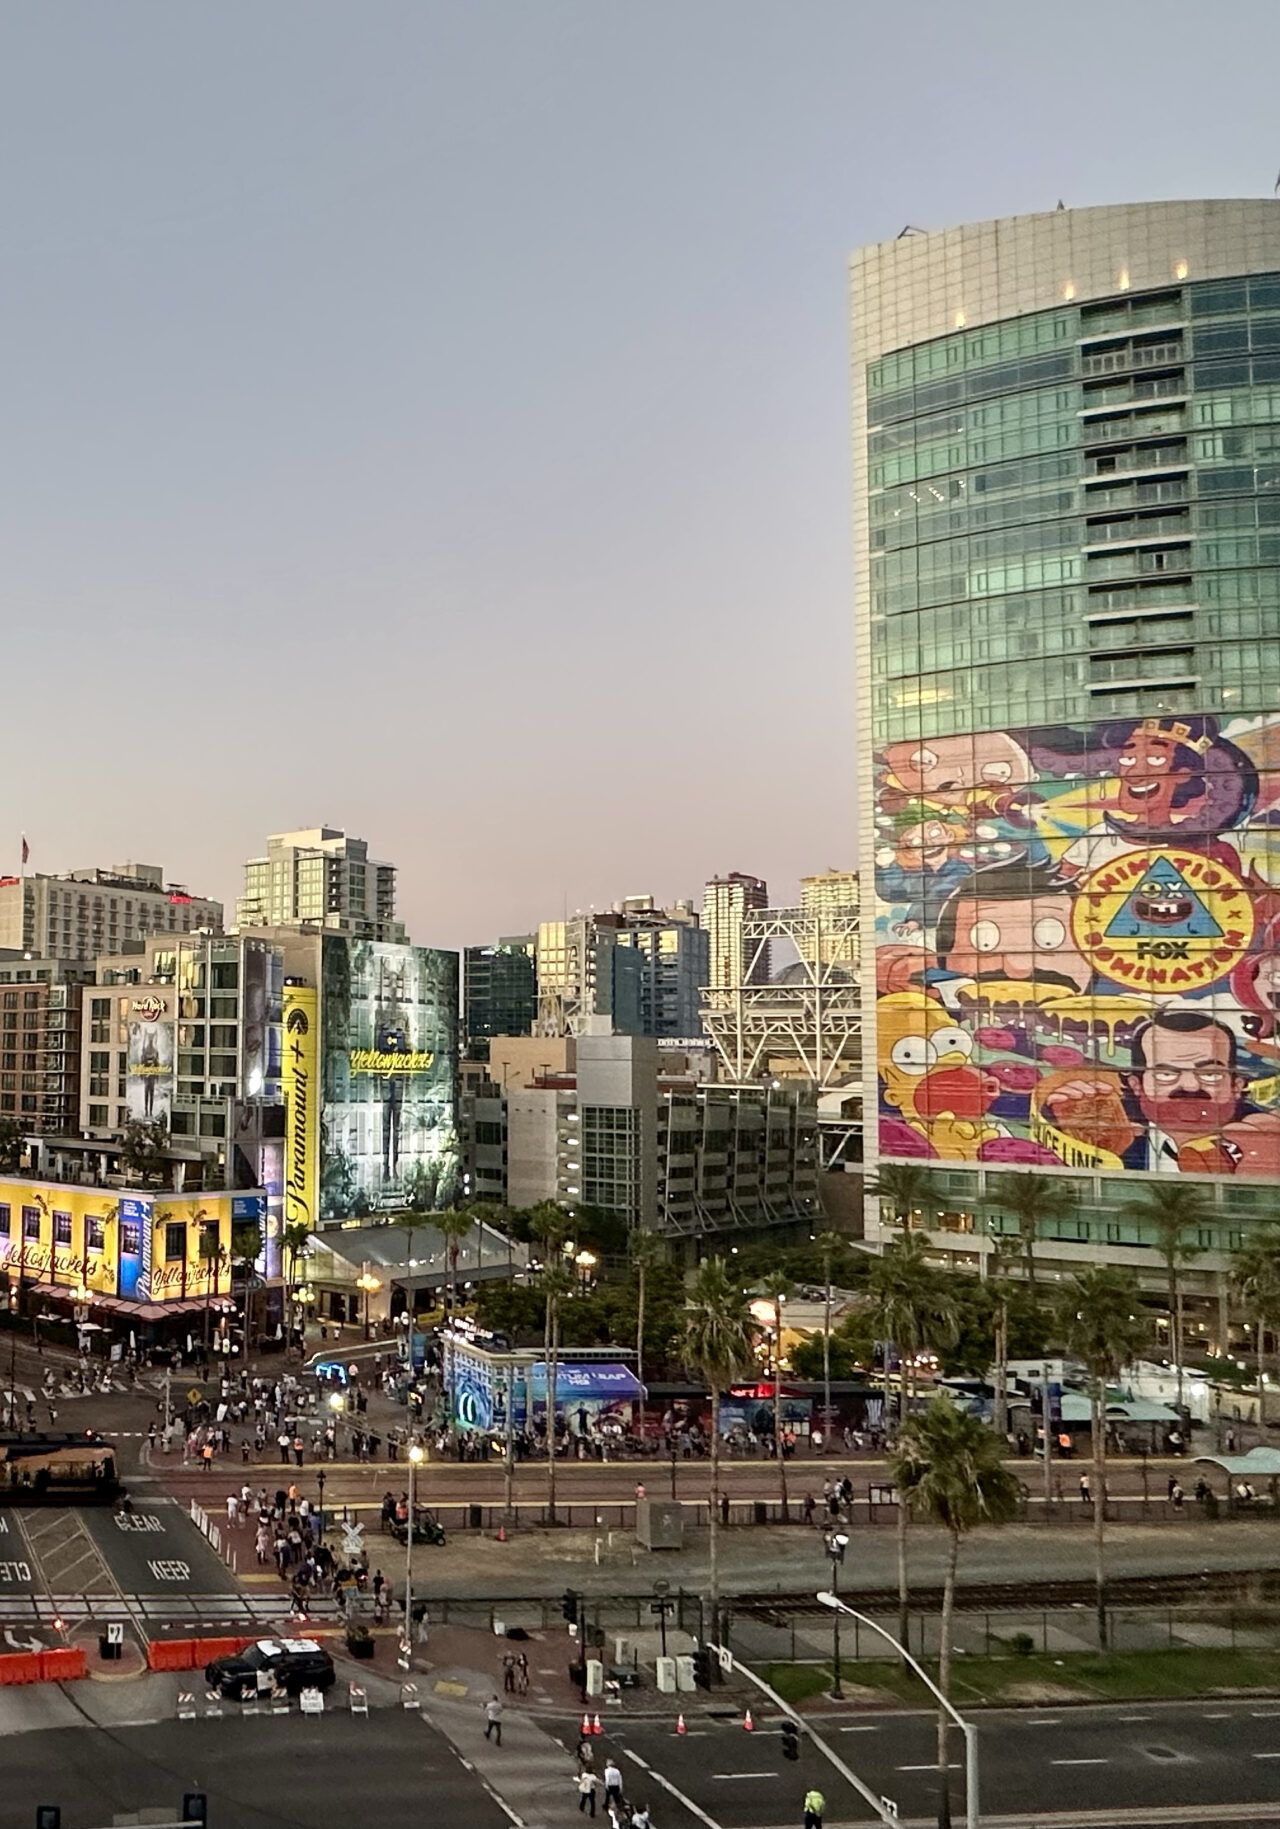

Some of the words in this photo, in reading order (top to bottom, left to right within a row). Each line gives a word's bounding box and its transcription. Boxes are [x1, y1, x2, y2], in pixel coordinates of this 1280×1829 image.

[1084, 929, 1246, 984] DOMINATION
[1137, 941, 1189, 960] FOX
[349, 1050, 435, 1078] Yellowjackets
[114, 1514, 167, 1533] CLEAR
[147, 1560, 192, 1580] KEEP
